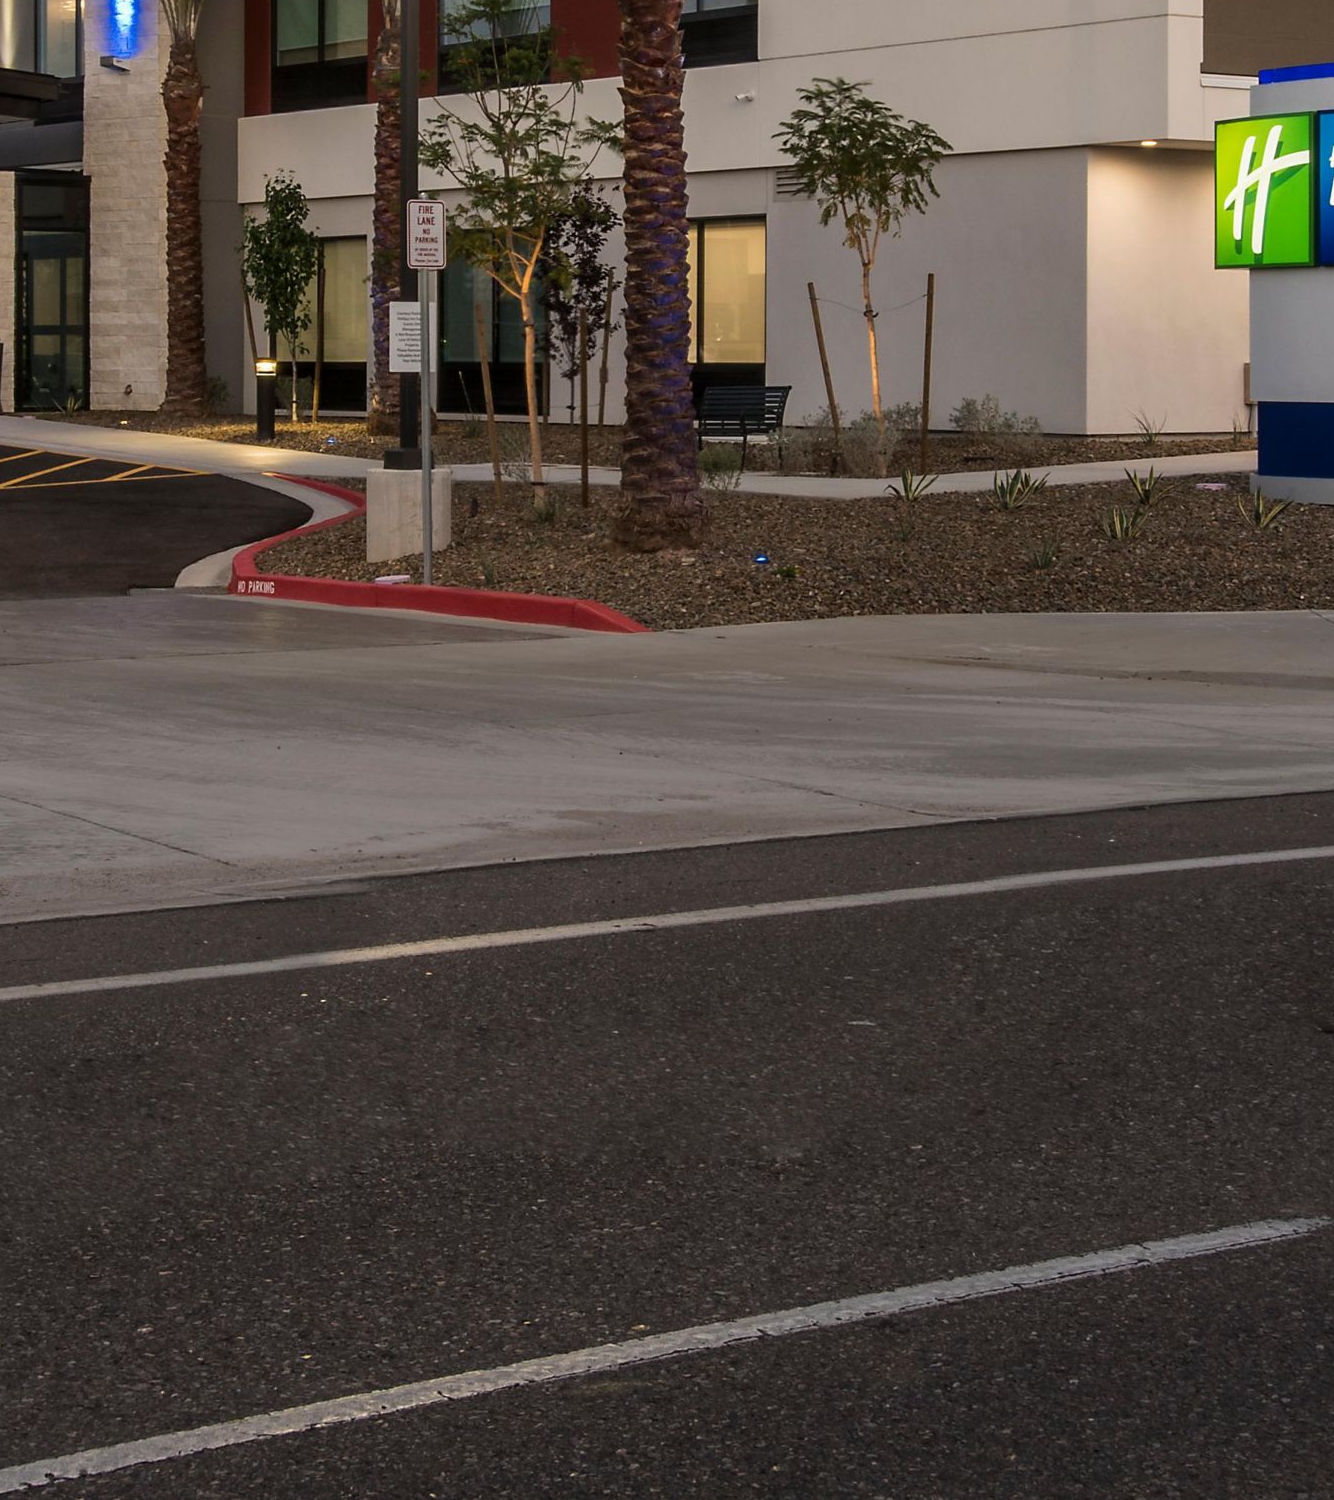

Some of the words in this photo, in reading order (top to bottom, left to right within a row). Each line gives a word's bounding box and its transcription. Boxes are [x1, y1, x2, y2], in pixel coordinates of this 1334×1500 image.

[418, 205, 434, 215] FIRE
[417, 216, 436, 226] LANE
[414, 236, 439, 244] PARKING
[237, 580, 246, 593] NO
[248, 580, 275, 594] PARKING
